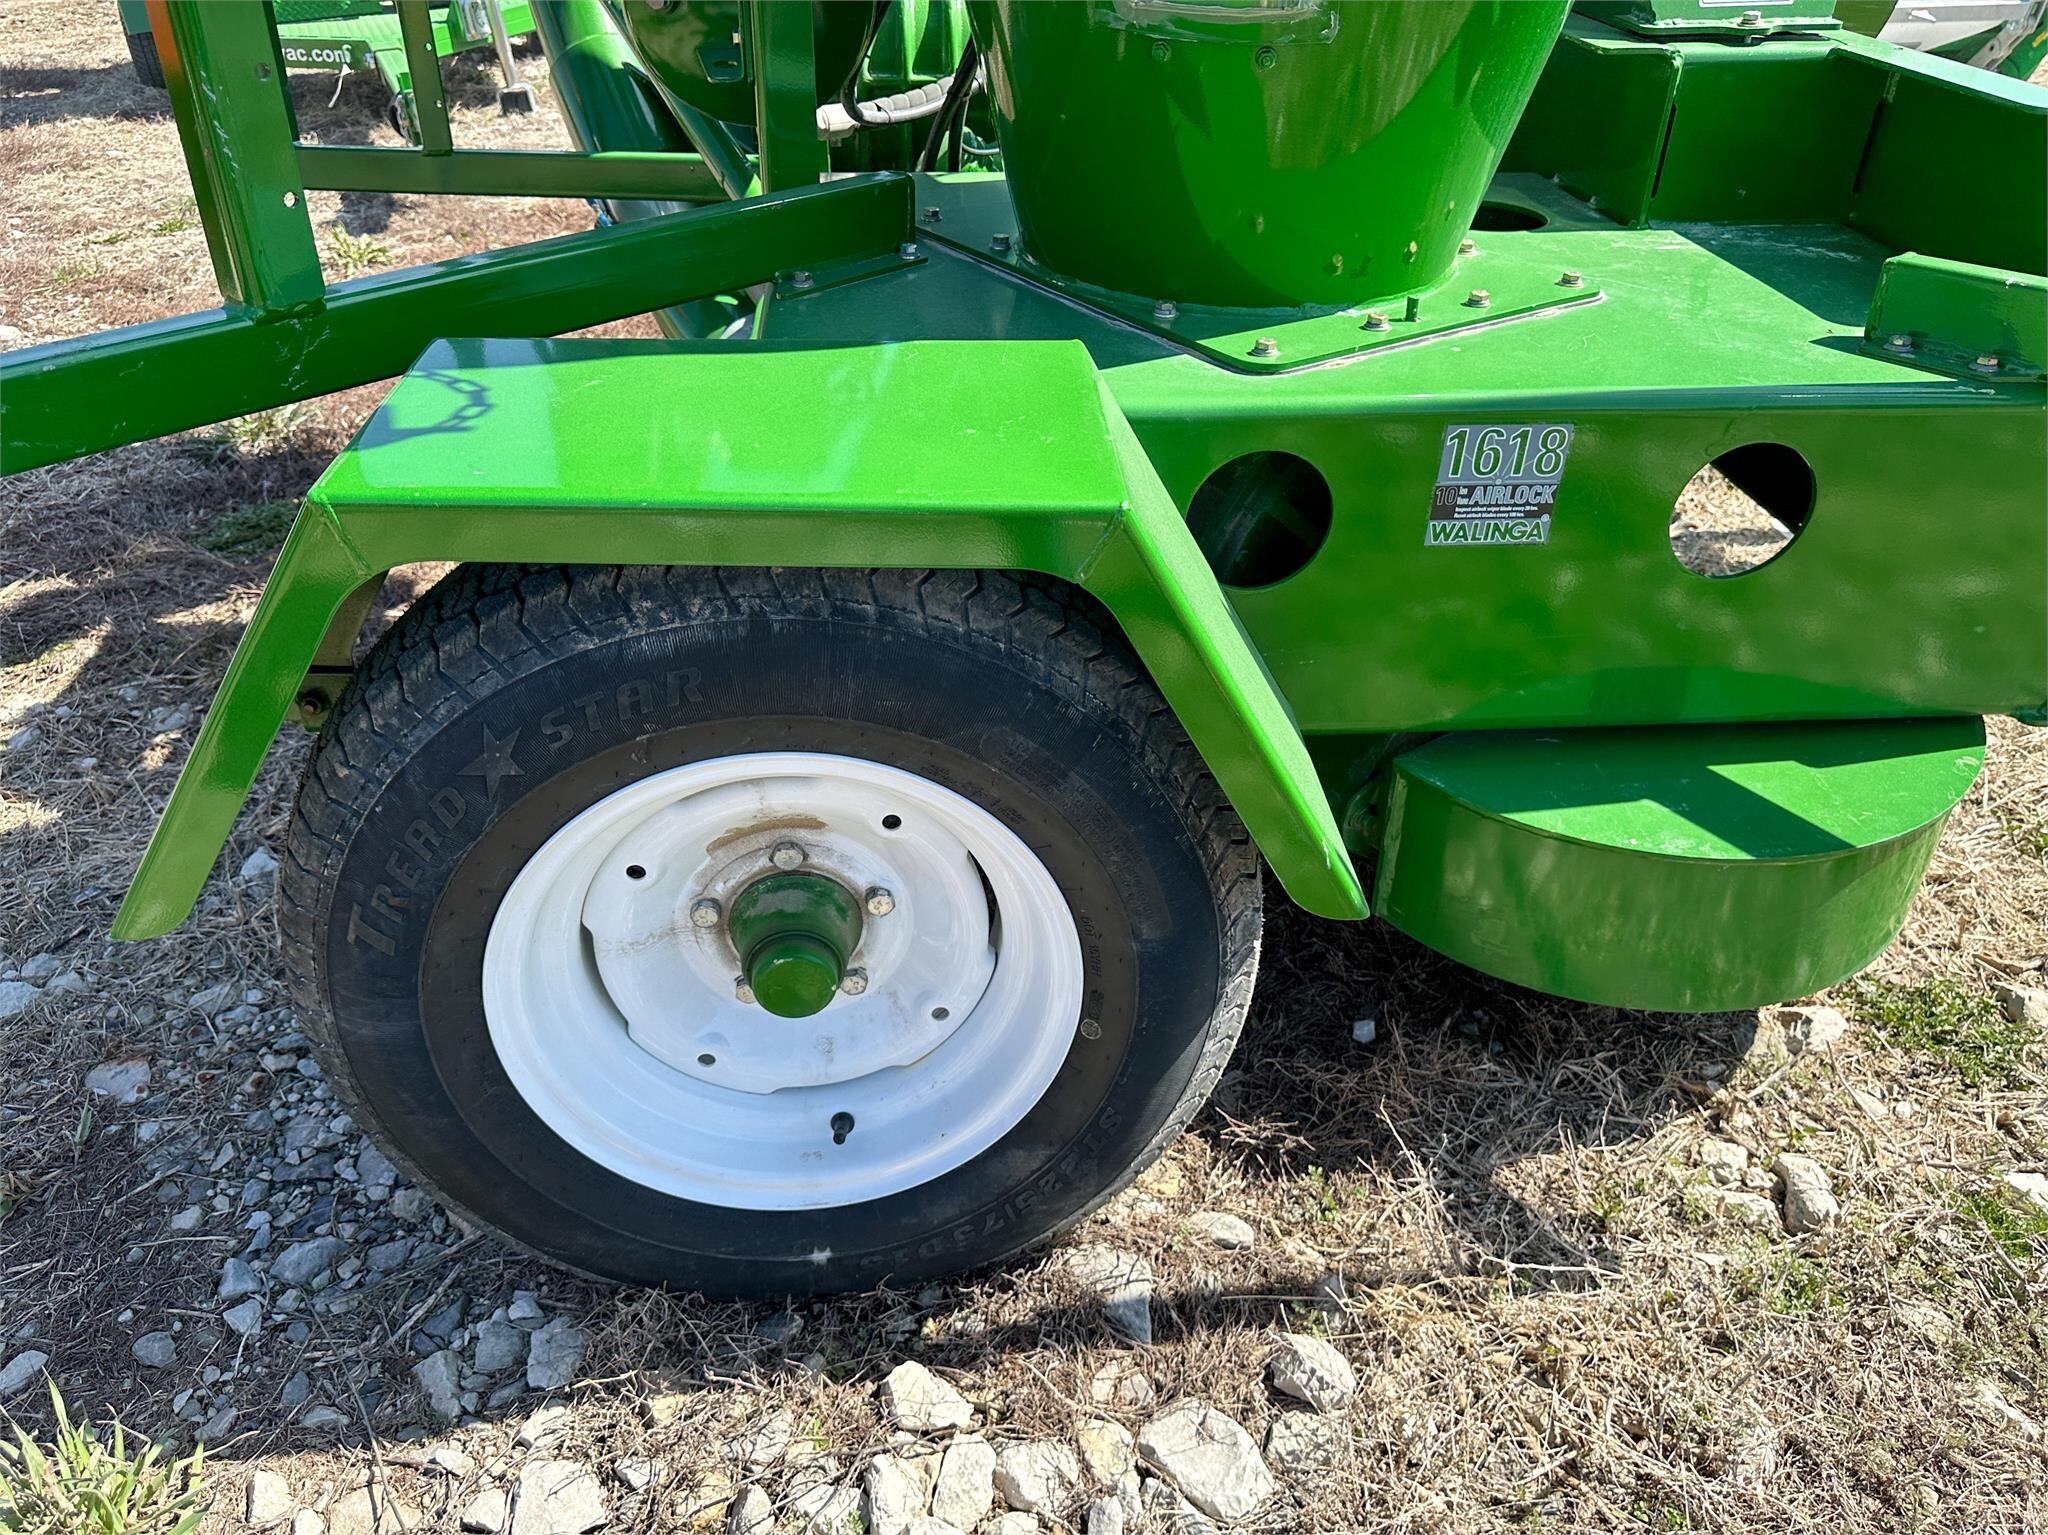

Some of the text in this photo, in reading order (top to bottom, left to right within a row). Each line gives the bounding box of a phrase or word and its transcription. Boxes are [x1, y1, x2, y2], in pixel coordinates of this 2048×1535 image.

[281, 46, 351, 63] ac.com
[1447, 427, 1569, 478] 1618
[1436, 487, 1458, 505] 10
[1469, 485, 1557, 505] AIRLOCK
[1430, 519, 1544, 544] WALINGA
[347, 666, 702, 957] TREAD STAR
